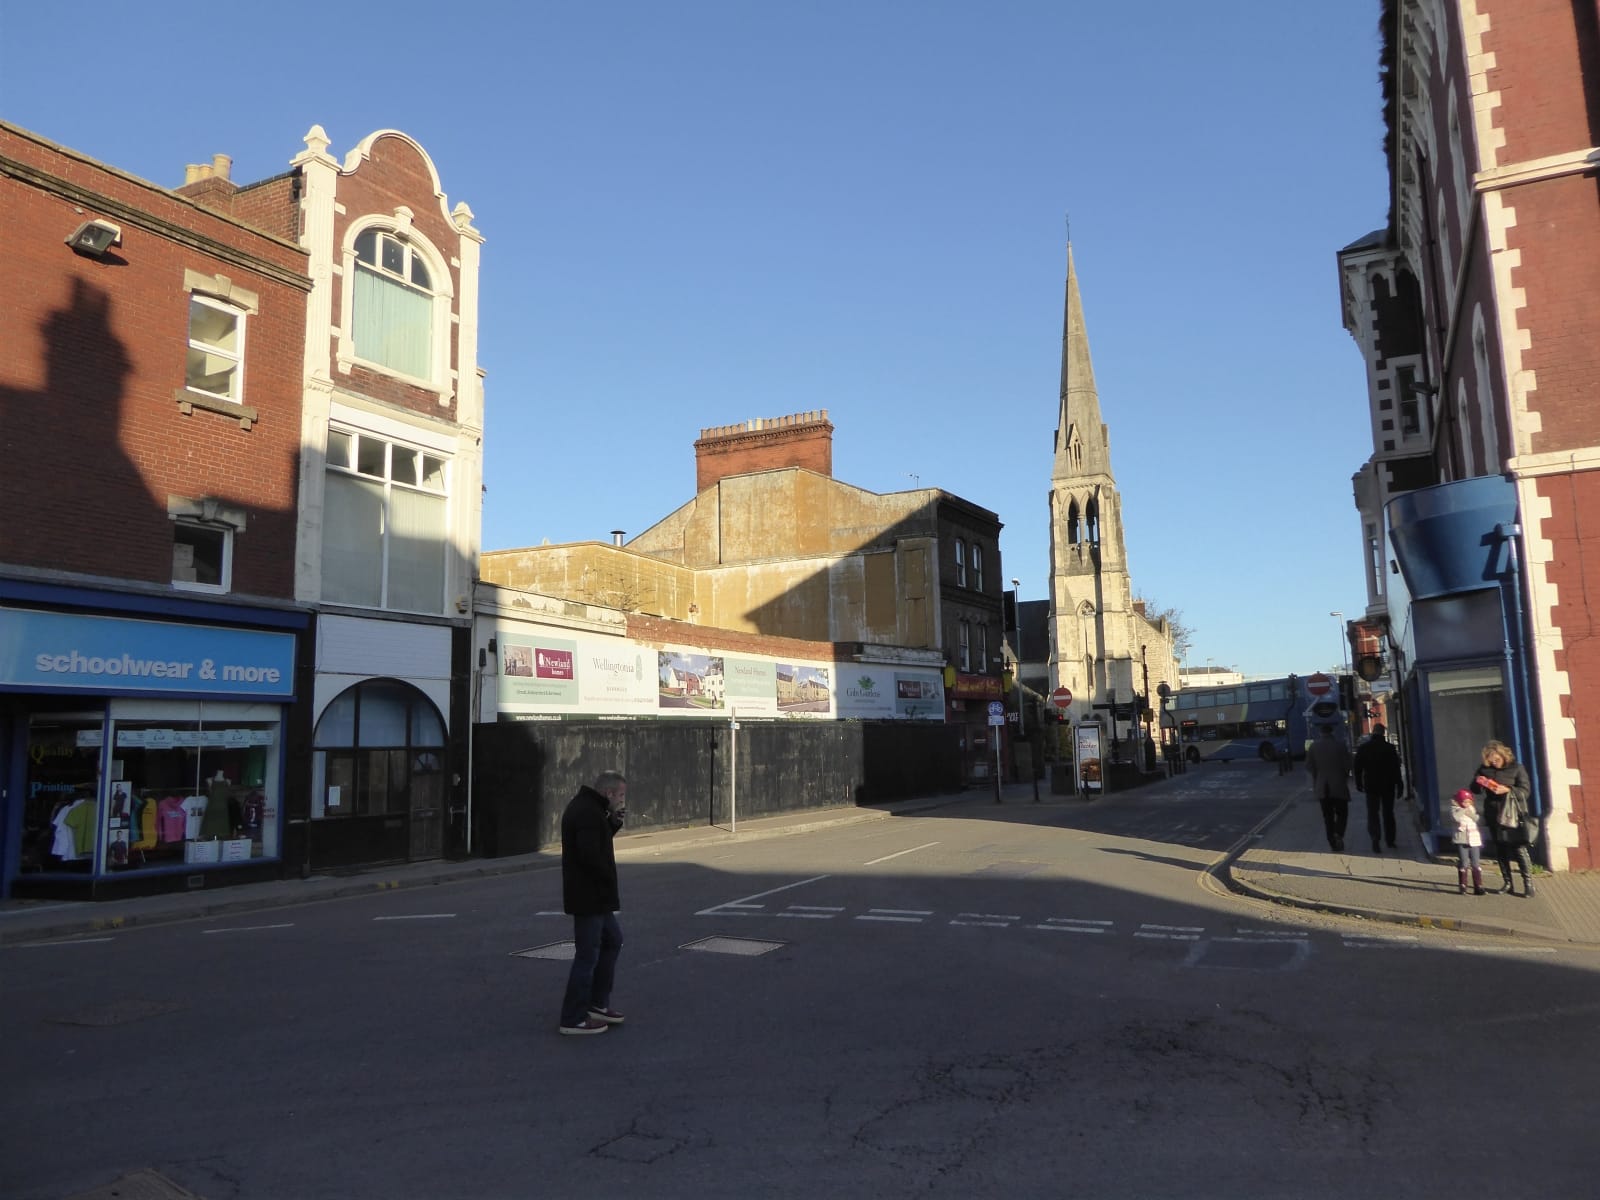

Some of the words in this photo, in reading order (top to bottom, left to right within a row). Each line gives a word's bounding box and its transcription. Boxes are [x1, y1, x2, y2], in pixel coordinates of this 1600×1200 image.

[35, 650, 193, 680] schoolwear
[199, 658, 217, 681] &
[222, 665, 281, 684] more
[544, 656, 571, 669] Newland
[592, 657, 635, 675] Wellingtonia
[31, 781, 76, 798] Printing
